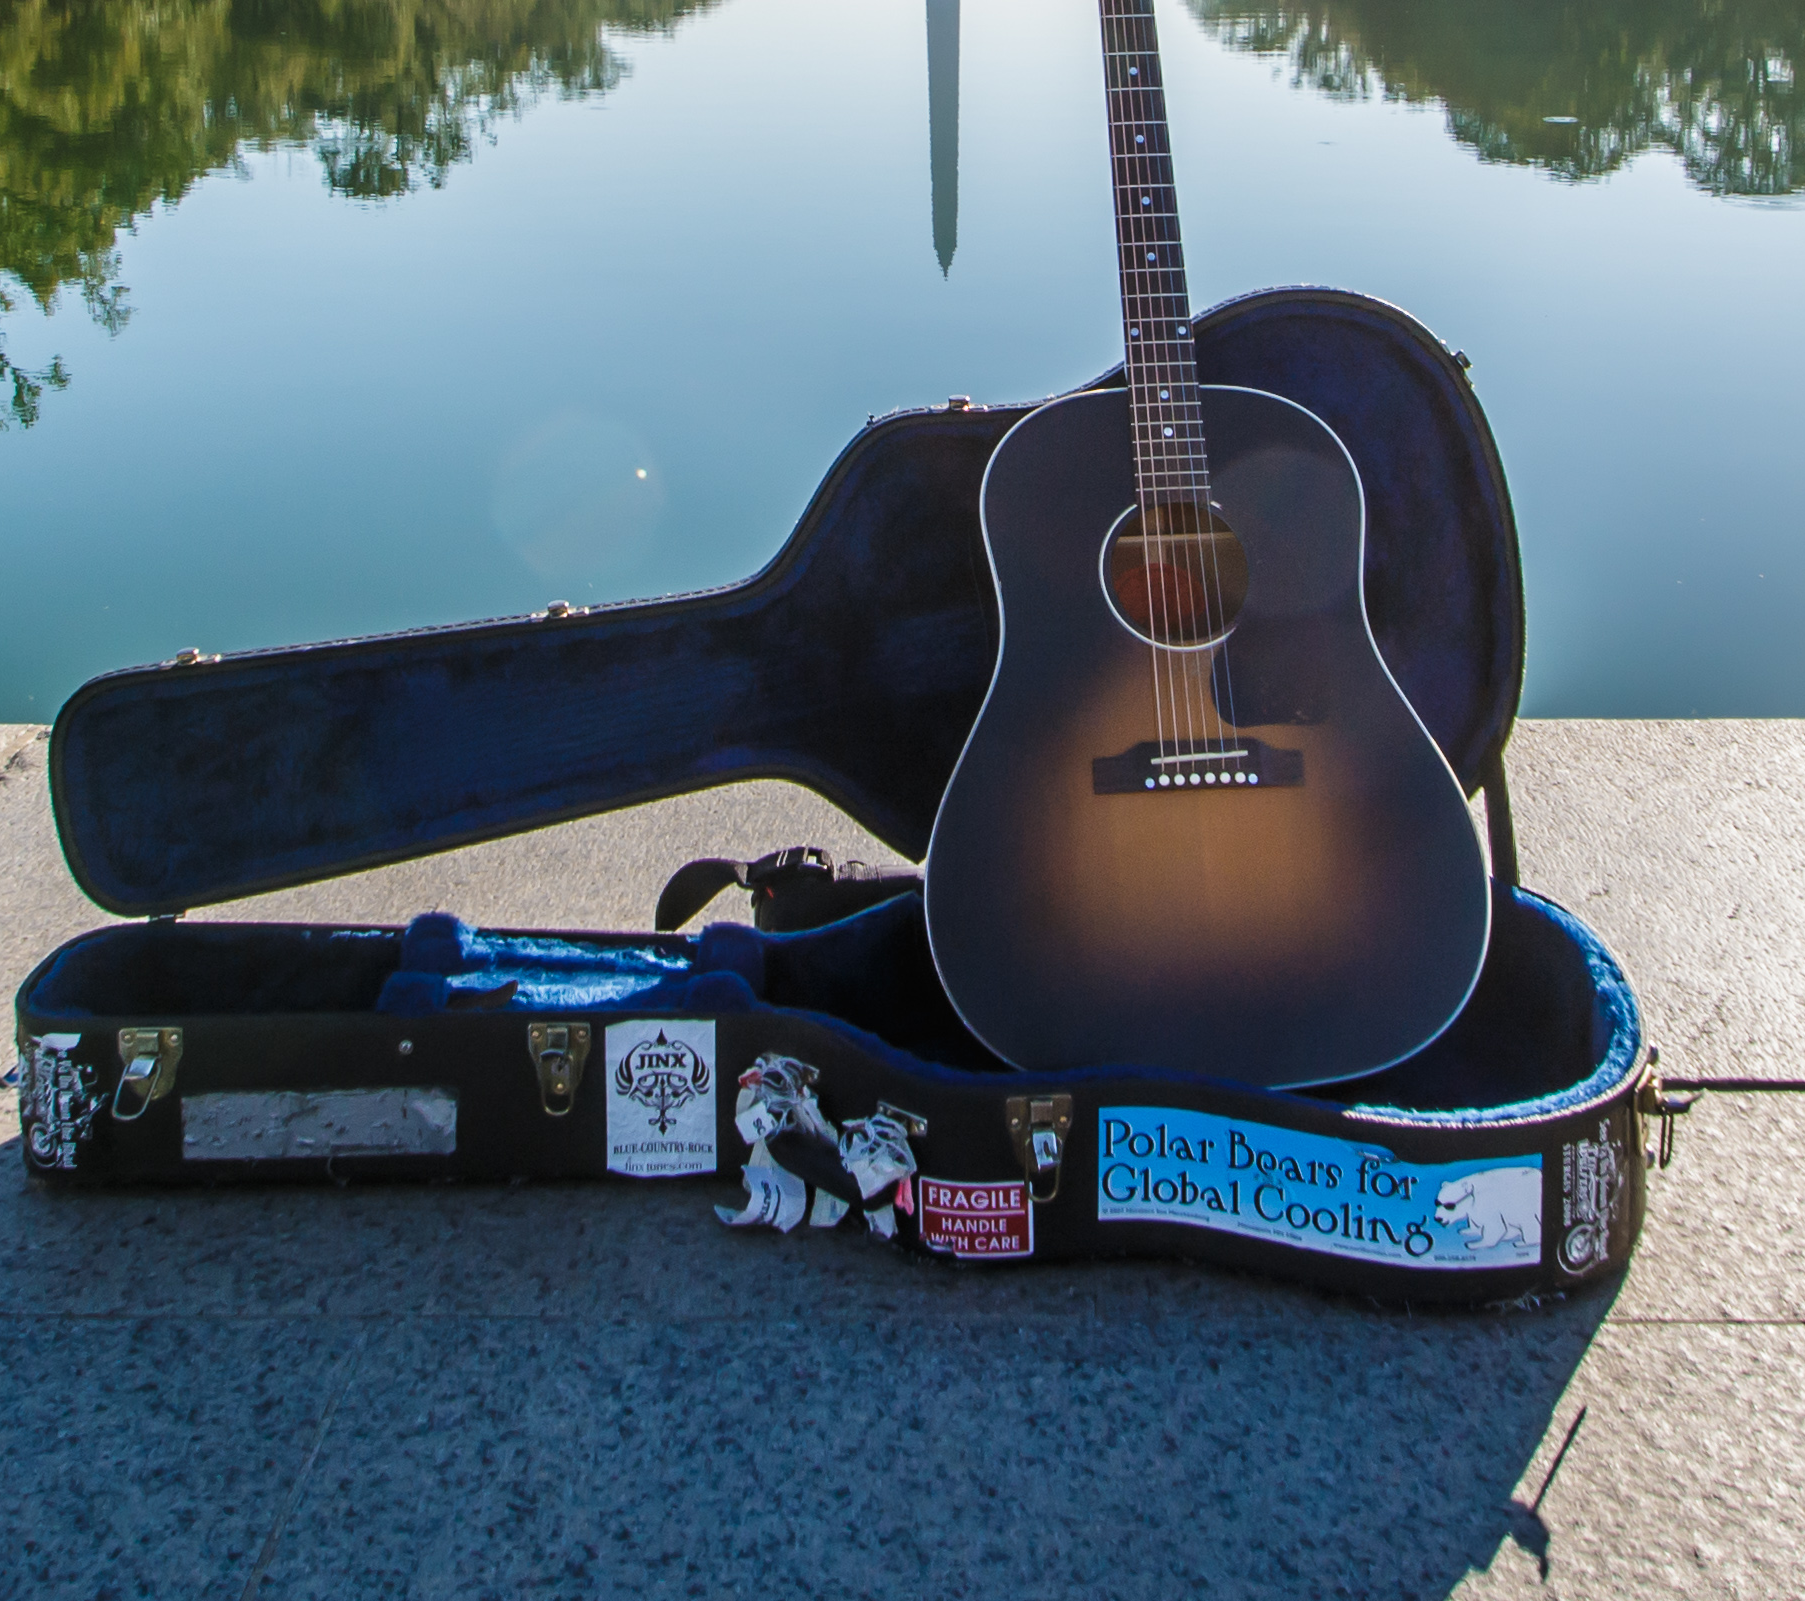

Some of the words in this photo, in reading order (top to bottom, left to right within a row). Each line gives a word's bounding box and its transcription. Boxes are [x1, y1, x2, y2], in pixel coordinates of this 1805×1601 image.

[635, 1053, 687, 1070] JINX
[1102, 1118, 1217, 1164] Polar
[1228, 1128, 1344, 1189] Bears
[1355, 1158, 1419, 1200] for
[928, 1186, 1021, 1209] FRAGILE
[1101, 1162, 1241, 1216] Global
[1253, 1182, 1435, 1258] Cooling
[941, 1217, 1008, 1233] HANDLE
[931, 1232, 969, 1251] WITH
[974, 1235, 1020, 1251] CARE
